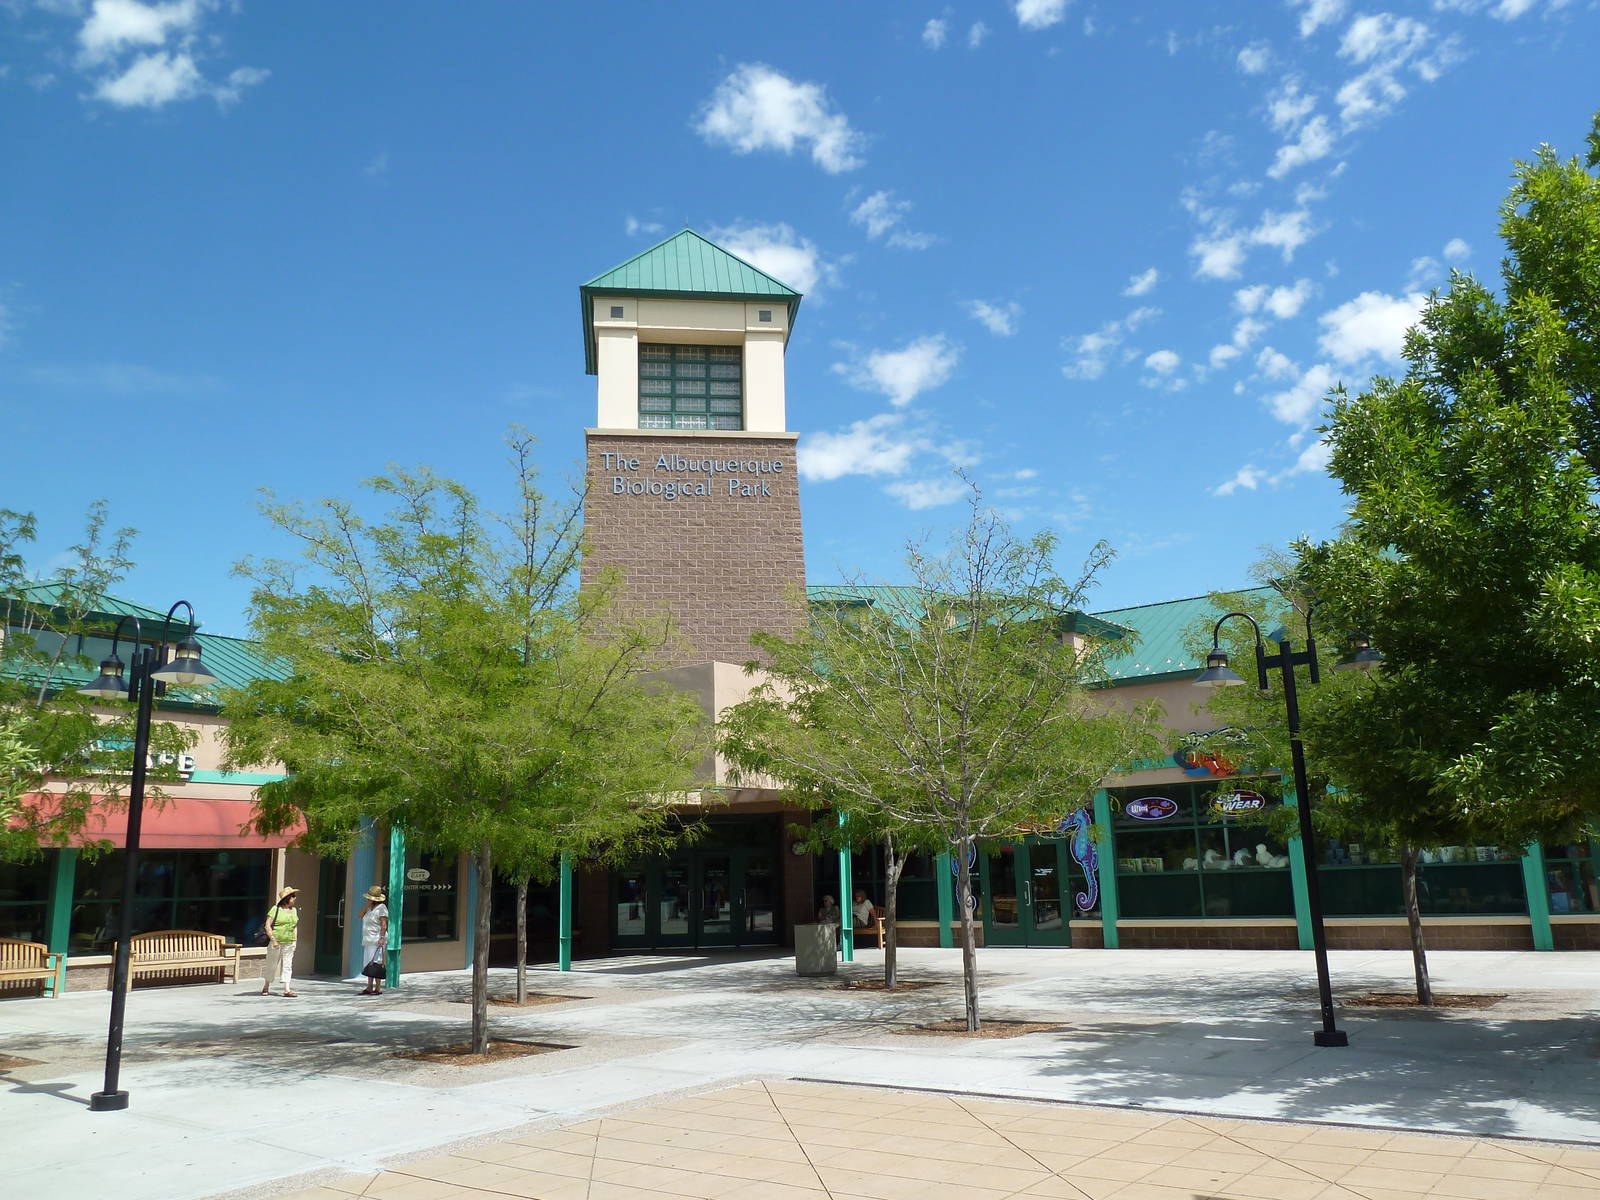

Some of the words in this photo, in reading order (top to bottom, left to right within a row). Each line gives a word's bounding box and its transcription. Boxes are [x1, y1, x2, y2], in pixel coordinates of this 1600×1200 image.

[600, 451, 640, 471] The
[654, 454, 783, 477] Albuquerque
[612, 475, 712, 500] Biological
[727, 478, 772, 497] Park
[1222, 799, 1261, 811] WEAR
